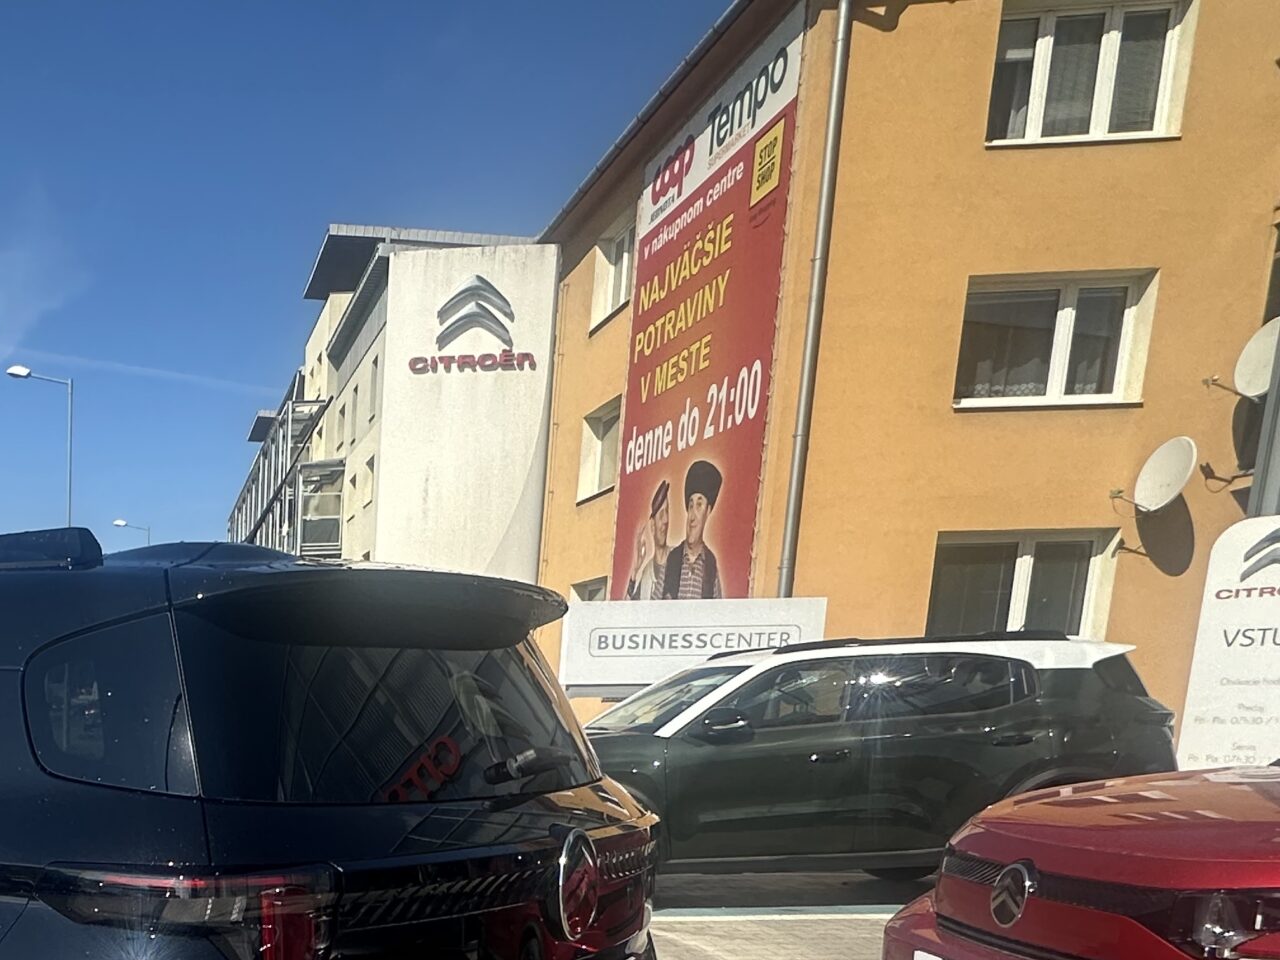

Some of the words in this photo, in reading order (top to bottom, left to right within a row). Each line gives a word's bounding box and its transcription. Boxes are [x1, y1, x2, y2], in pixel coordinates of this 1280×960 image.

[706, 47, 789, 157] Tempo
[755, 161, 776, 192] SHOP
[758, 136, 778, 167] STOP
[643, 244, 651, 260] v
[651, 197, 704, 252] nákupnom
[706, 160, 744, 206] centre
[638, 213, 734, 315] NAJVÄČŠIE
[634, 269, 731, 363] POTRAVINY
[408, 349, 537, 375] CITROËN
[639, 373, 653, 404] V
[653, 332, 713, 398] MESTE
[625, 425, 673, 475] denne
[677, 397, 700, 452] do
[703, 359, 762, 440] 21:00
[1215, 586, 1280, 600] CITR
[597, 631, 791, 651] BUSINESSCENTER
